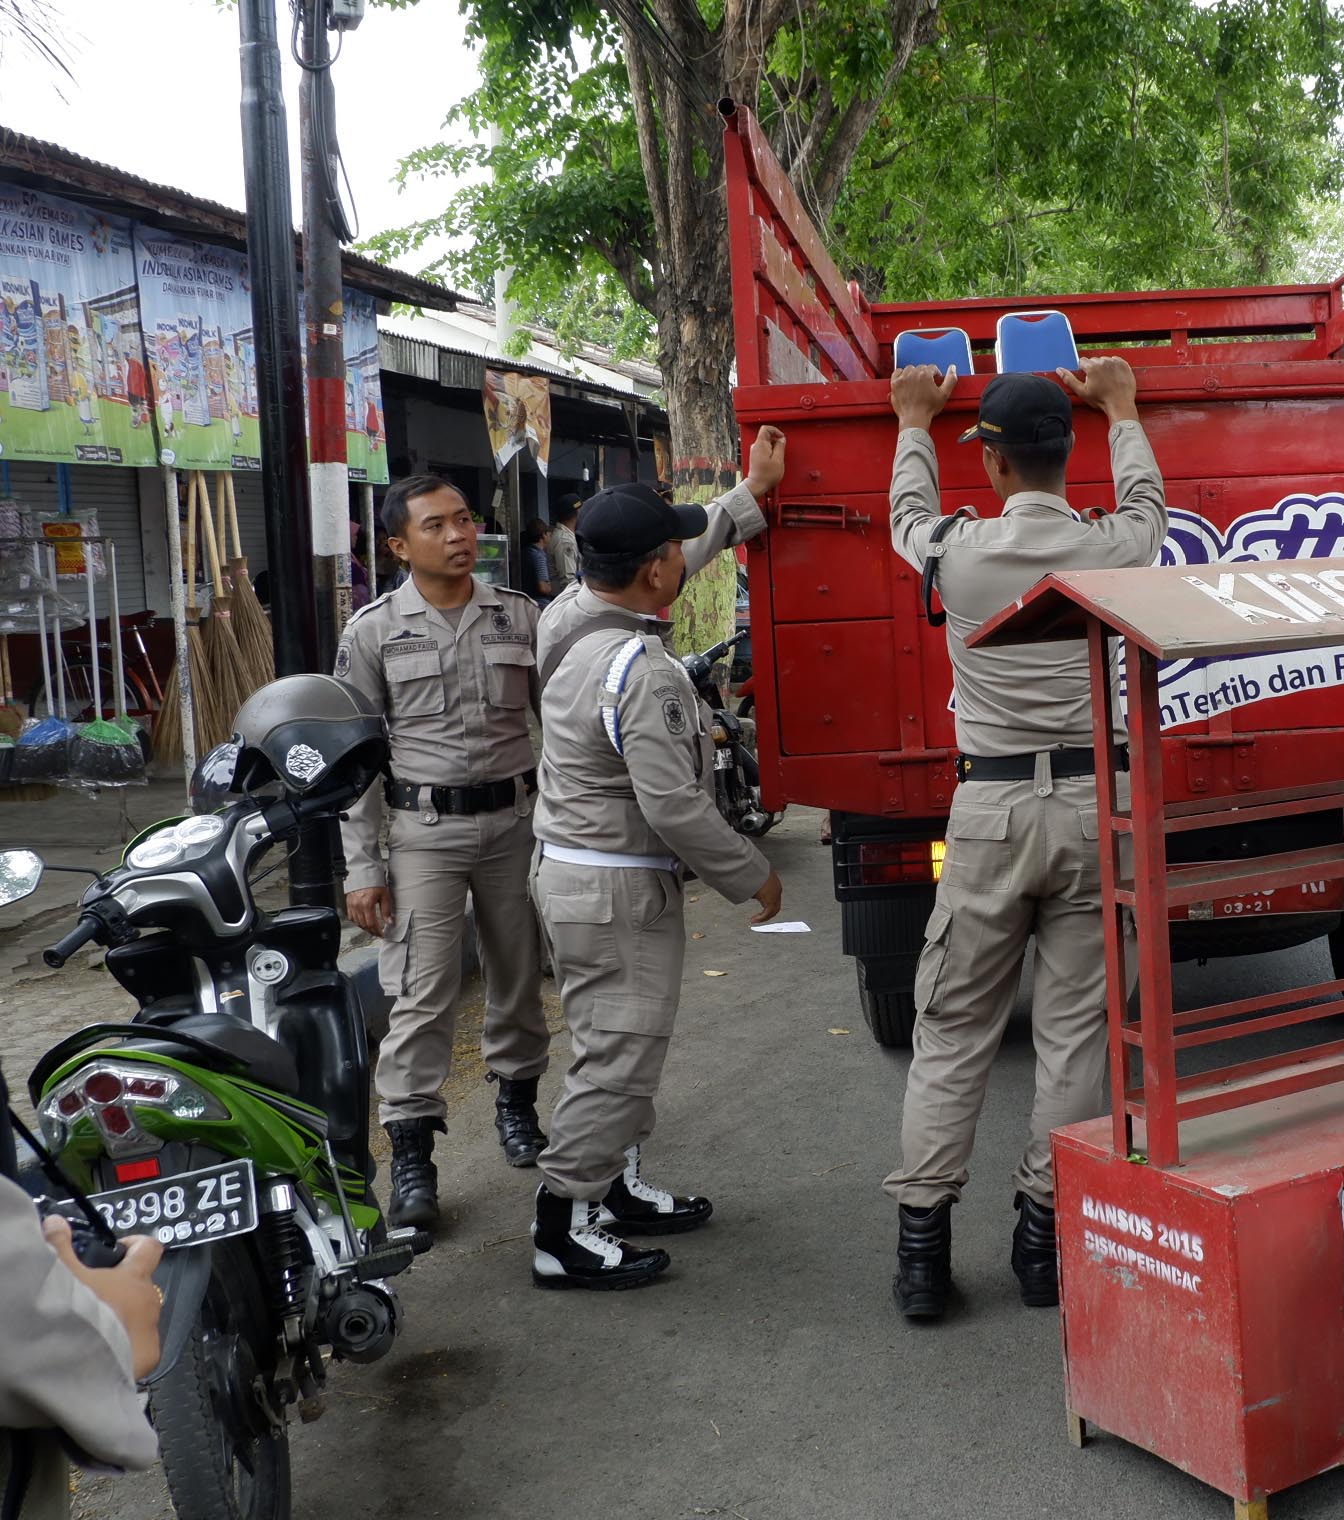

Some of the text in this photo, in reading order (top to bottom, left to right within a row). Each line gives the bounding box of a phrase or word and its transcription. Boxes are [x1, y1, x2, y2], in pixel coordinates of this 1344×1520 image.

[10, 221, 44, 242] ASIAN
[49, 227, 84, 252] GAMES
[1268, 664, 1326, 694] dan
[196, 1170, 242, 1210] ZE
[1082, 1194, 1204, 1262] BANSOS 2015
